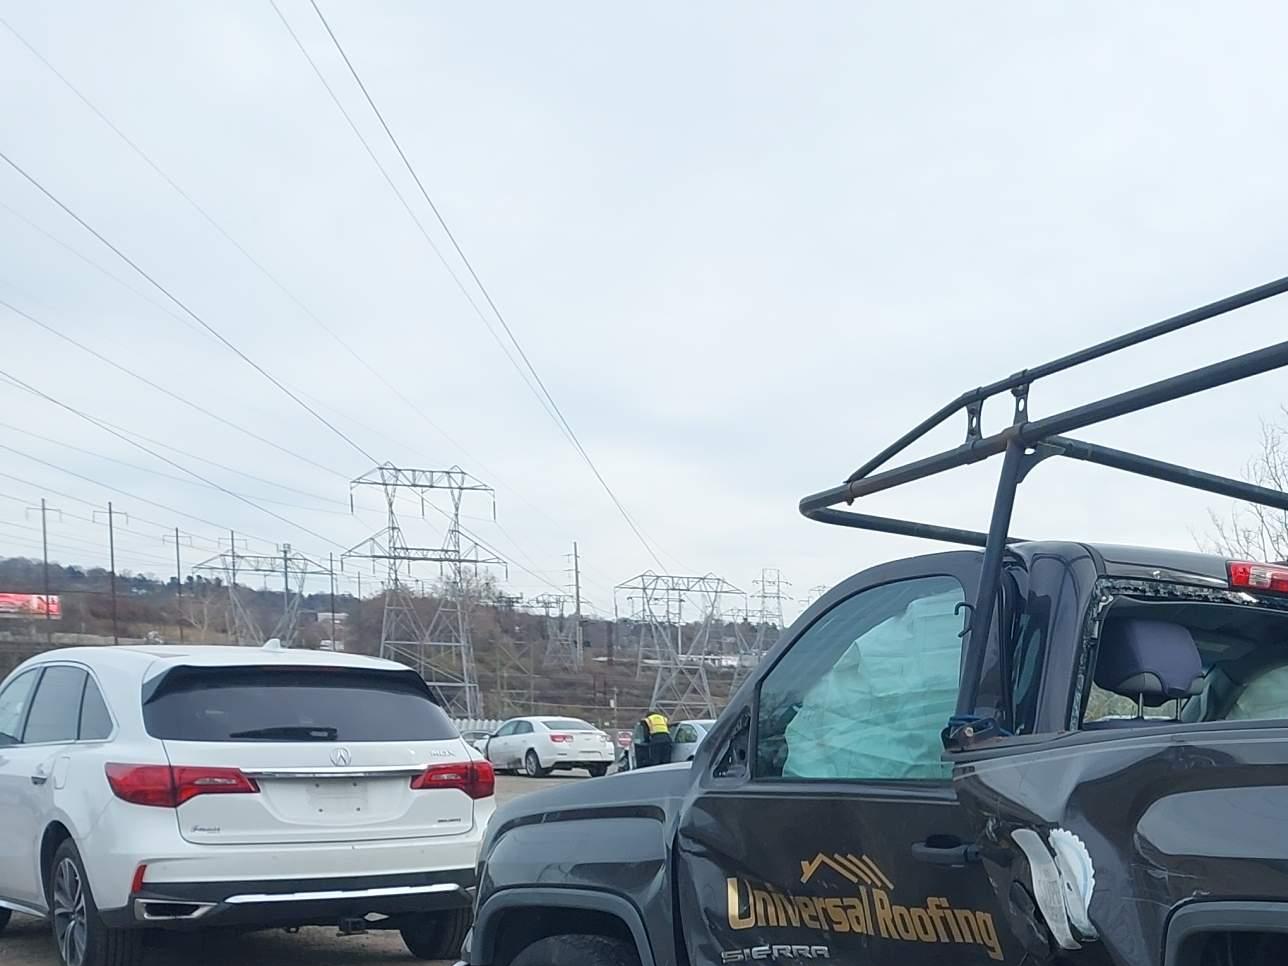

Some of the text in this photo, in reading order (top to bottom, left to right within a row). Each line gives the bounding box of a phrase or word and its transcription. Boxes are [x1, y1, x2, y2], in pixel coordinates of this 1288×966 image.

[727, 877, 875, 936] Universal
[872, 887, 1005, 961] Roofing
[721, 944, 831, 964] SIERRA
